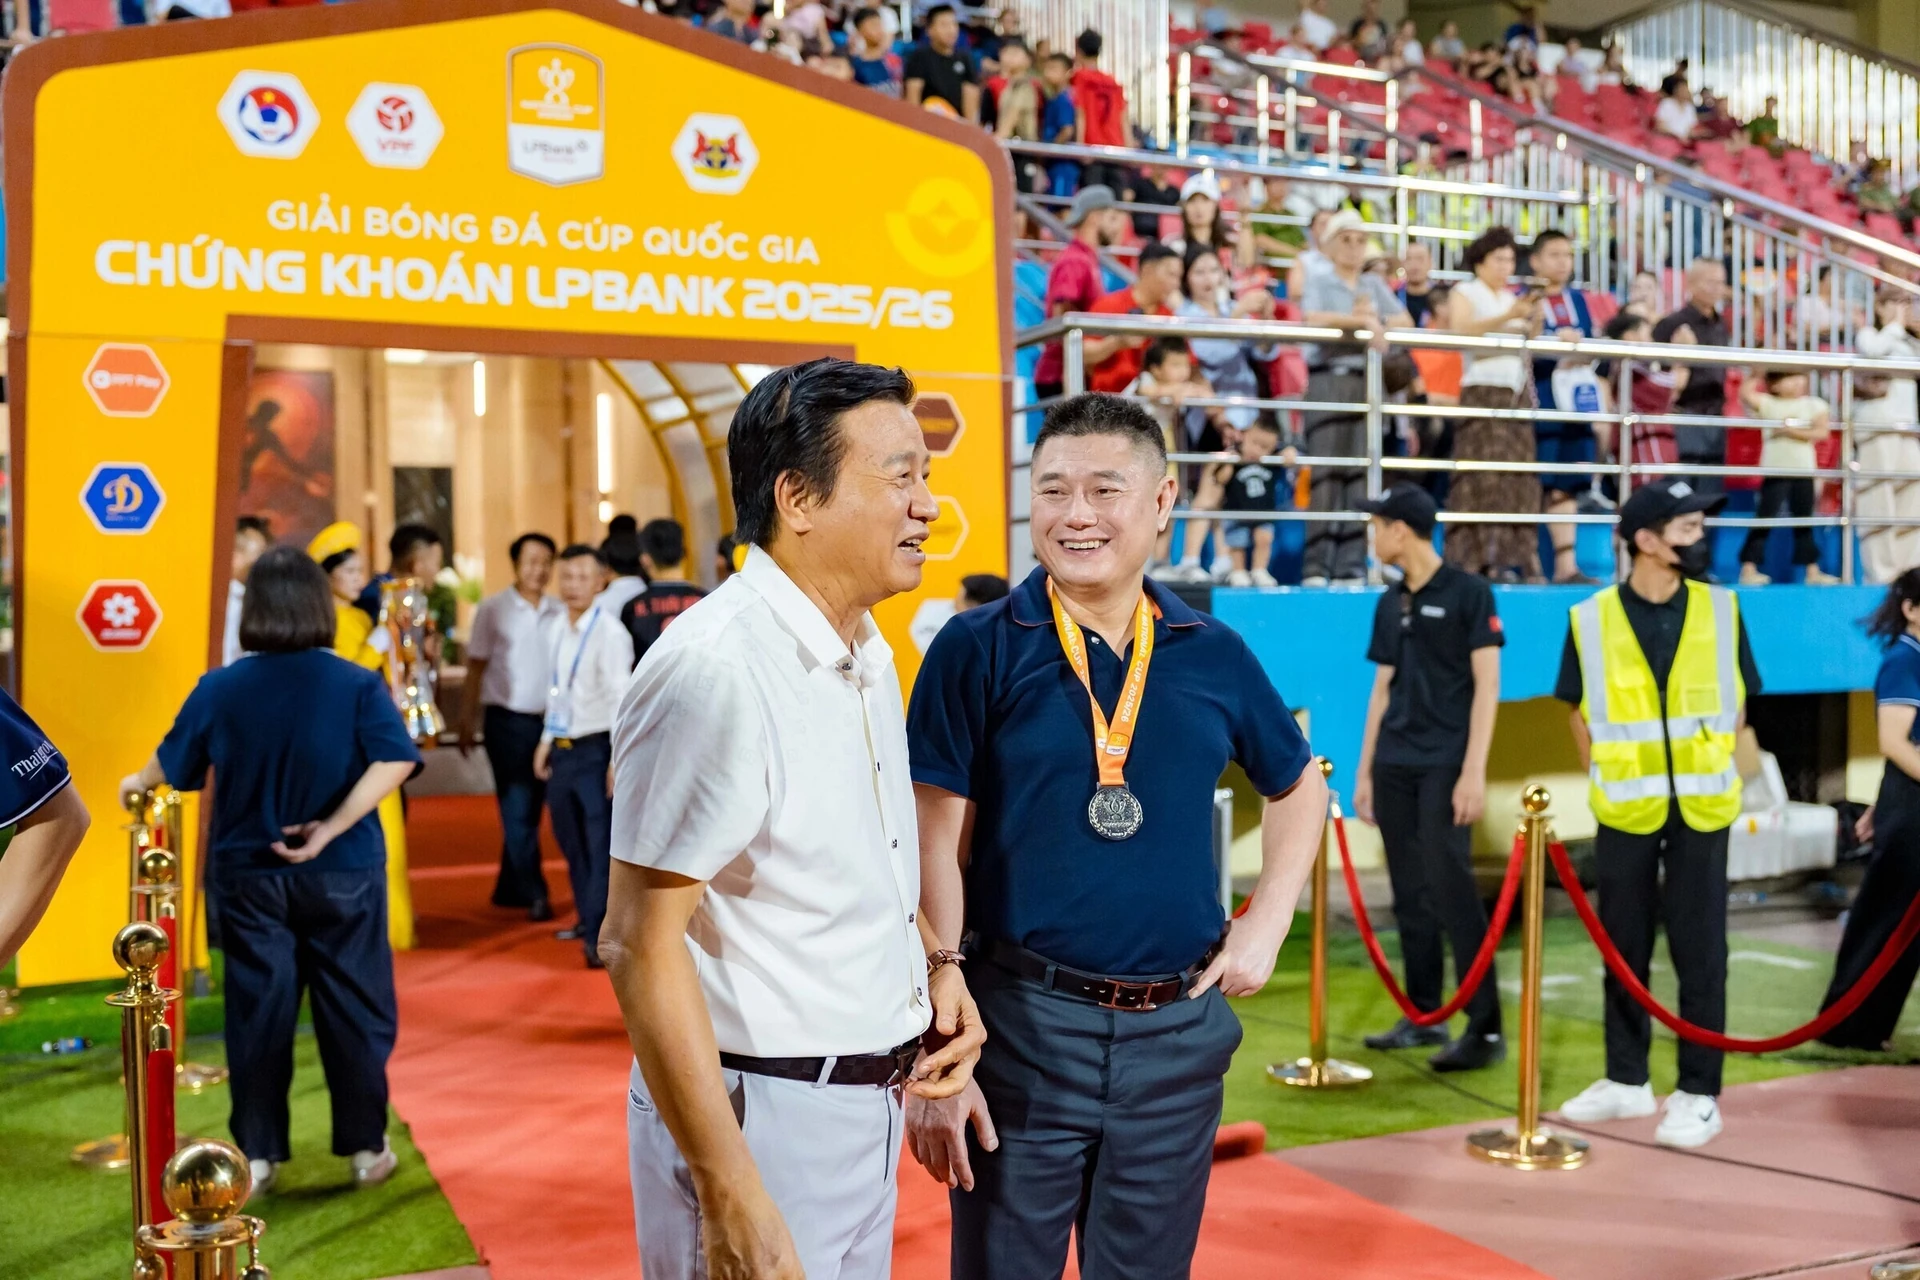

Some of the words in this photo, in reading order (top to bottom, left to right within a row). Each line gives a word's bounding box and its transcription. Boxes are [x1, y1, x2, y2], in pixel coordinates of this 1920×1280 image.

[267, 193, 351, 234] GIẢI
[364, 202, 480, 243] BÓNG
[490, 211, 548, 248] ĐÁ
[557, 216, 634, 252] CÚP
[643, 221, 749, 261] QUỐC
[758, 235, 820, 265] GIA
[94, 234, 306, 294] CHỨNG
[320, 250, 513, 306] KHOÁN
[526, 265, 735, 318] LPBANK
[742, 278, 954, 329] 2025/26
[1070, 645, 1083, 667] CUP
[1138, 613, 1149, 658] NATIONAL
[1133, 660, 1145, 682] CUP
[1120, 683, 1138, 723] 2025/26
